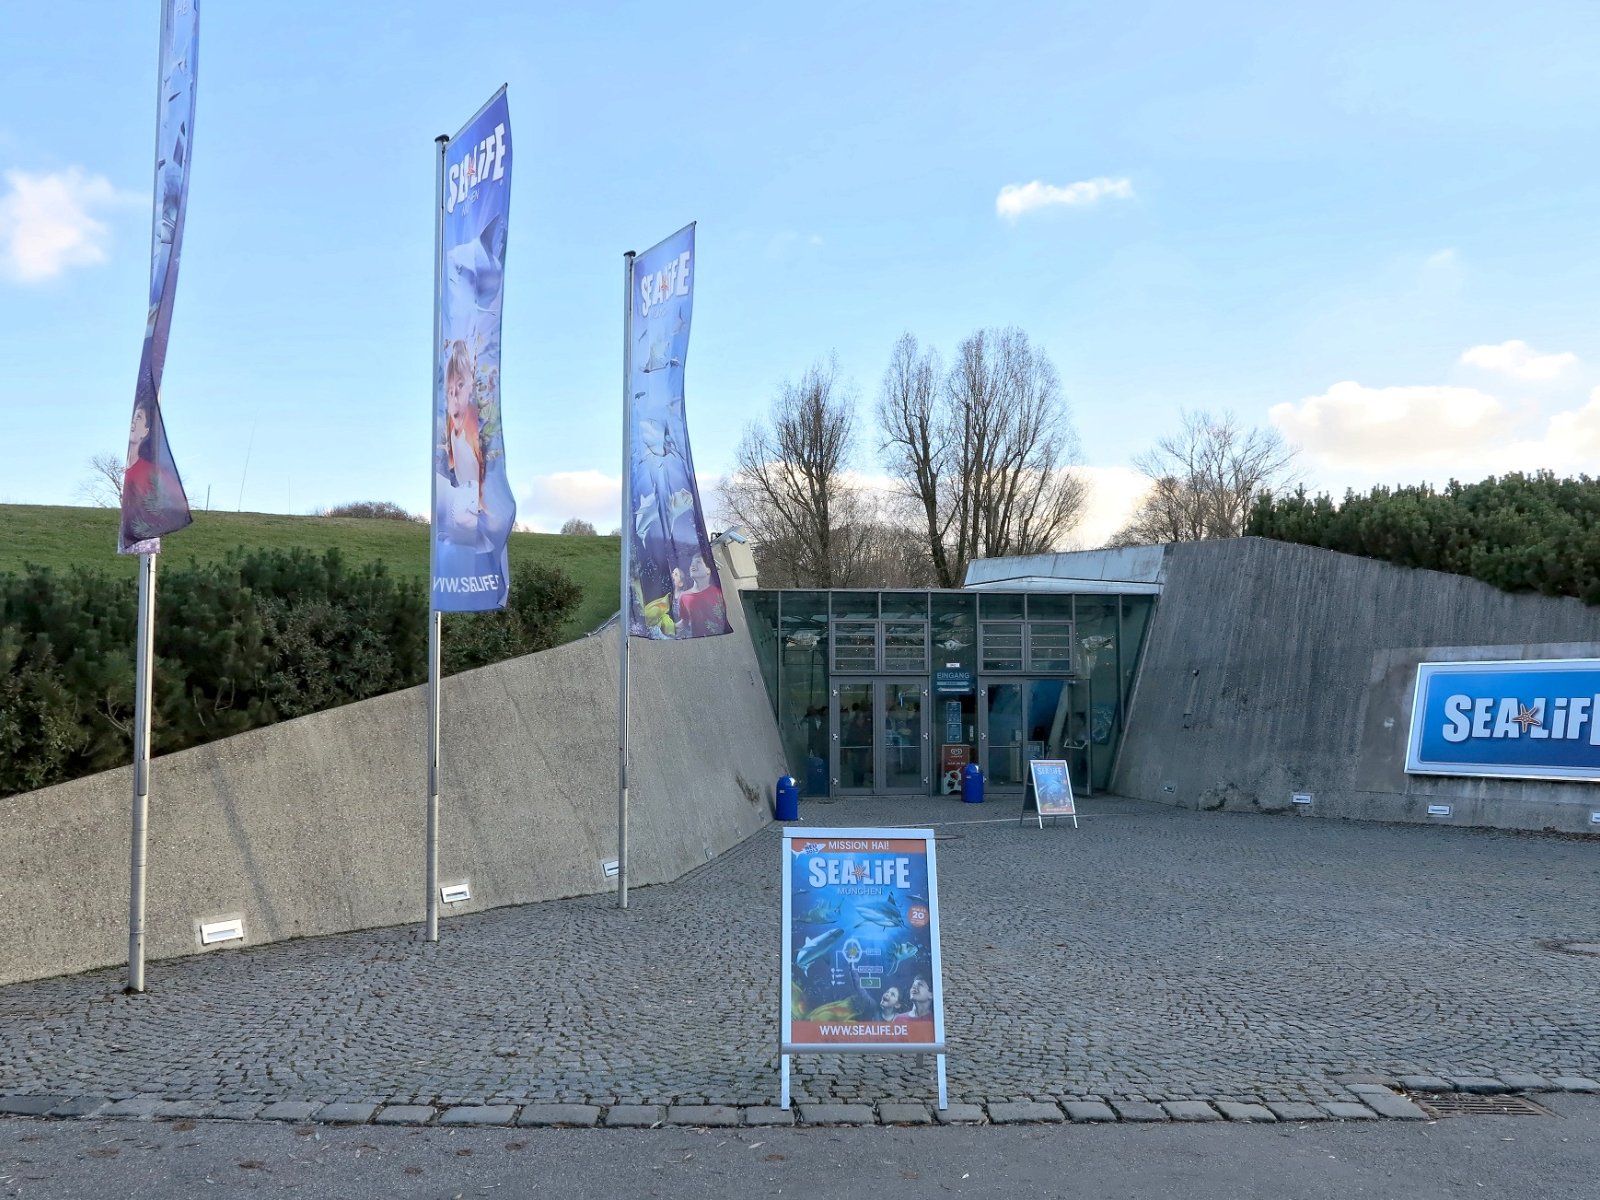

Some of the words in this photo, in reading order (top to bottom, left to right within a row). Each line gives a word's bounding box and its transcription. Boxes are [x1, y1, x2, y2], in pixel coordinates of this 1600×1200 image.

[828, 841, 868, 850] MISSION
[871, 840, 889, 850] HAI!
[912, 911, 925, 920] 20
[819, 1025, 908, 1036] WWW.SEALIFE.DE
